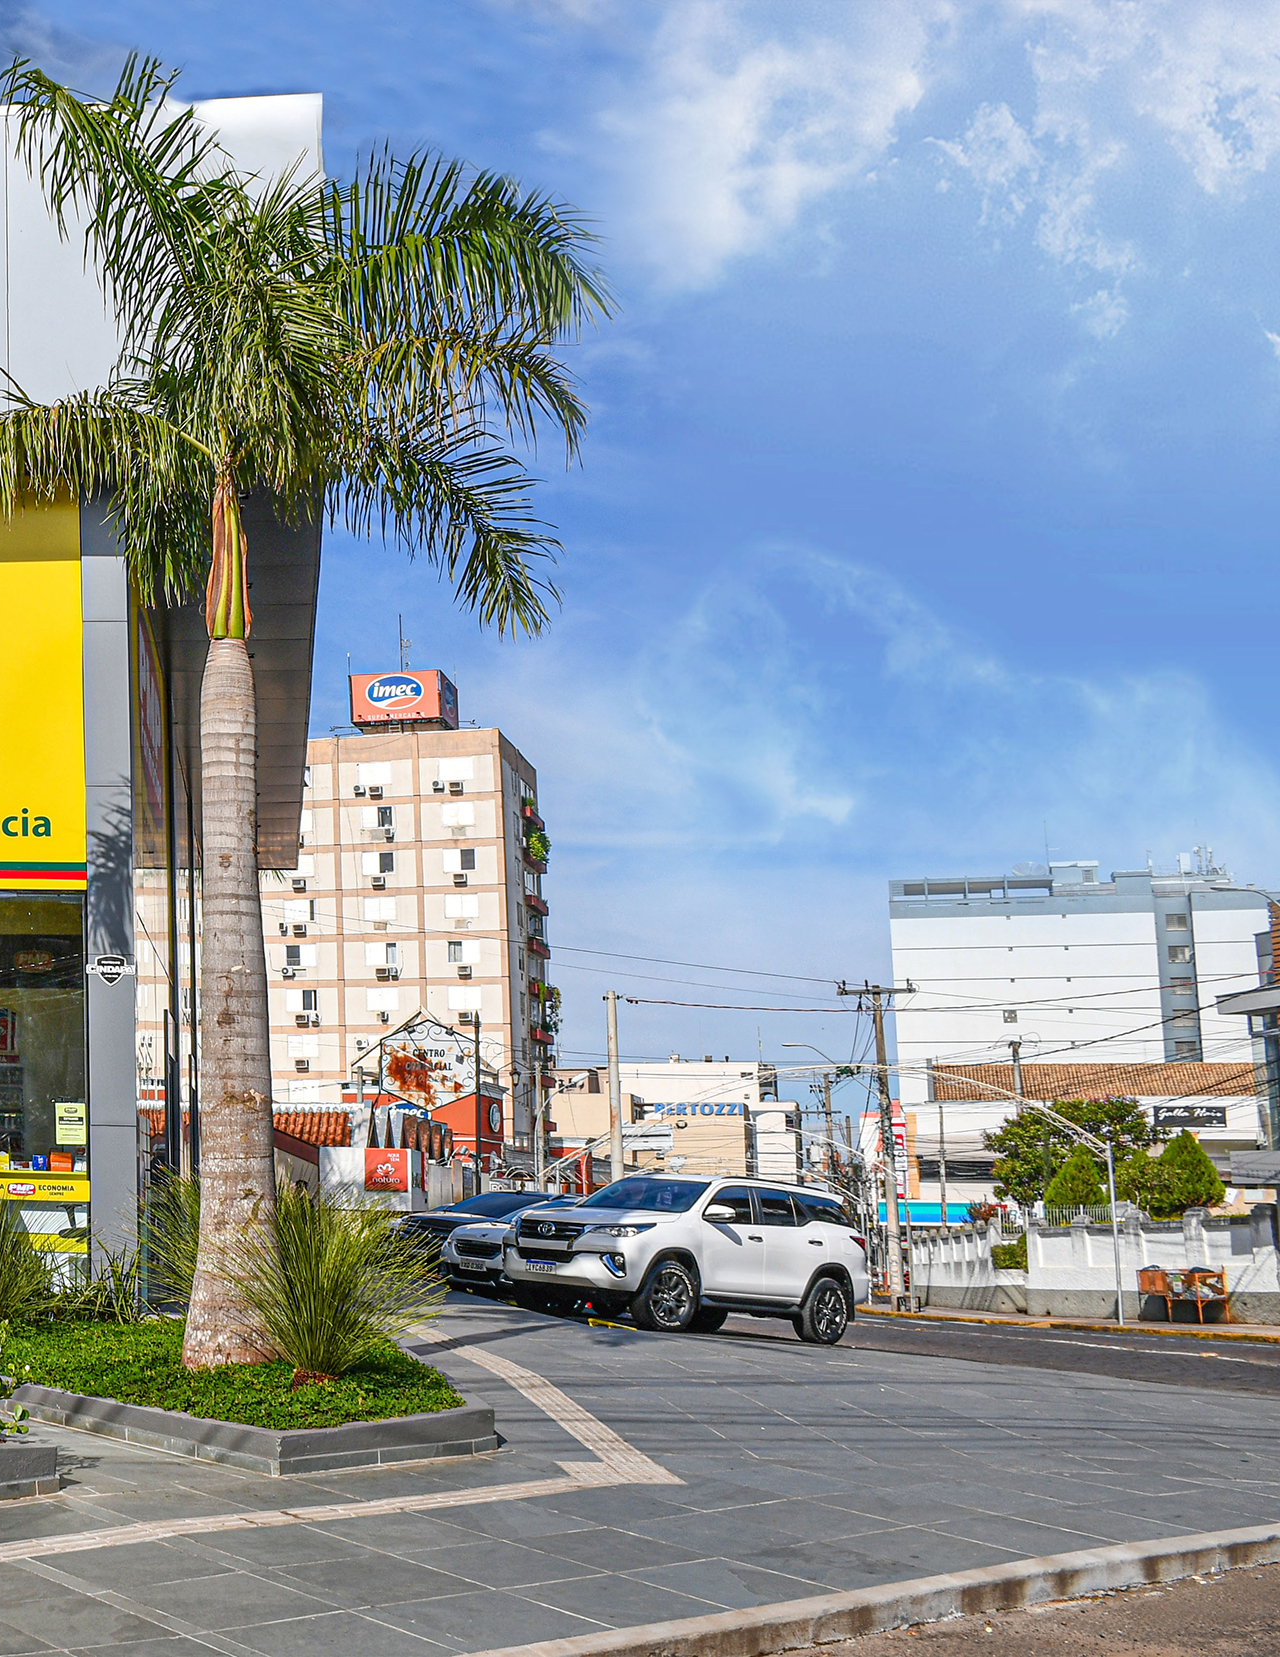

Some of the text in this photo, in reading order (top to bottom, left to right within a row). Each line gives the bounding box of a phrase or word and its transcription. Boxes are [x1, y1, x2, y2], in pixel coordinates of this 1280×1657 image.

[373, 682, 417, 698] imec
[653, 1102, 744, 1115] BERTOZZI
[372, 1175, 400, 1184] natura
[8, 1183, 35, 1191] PMP
